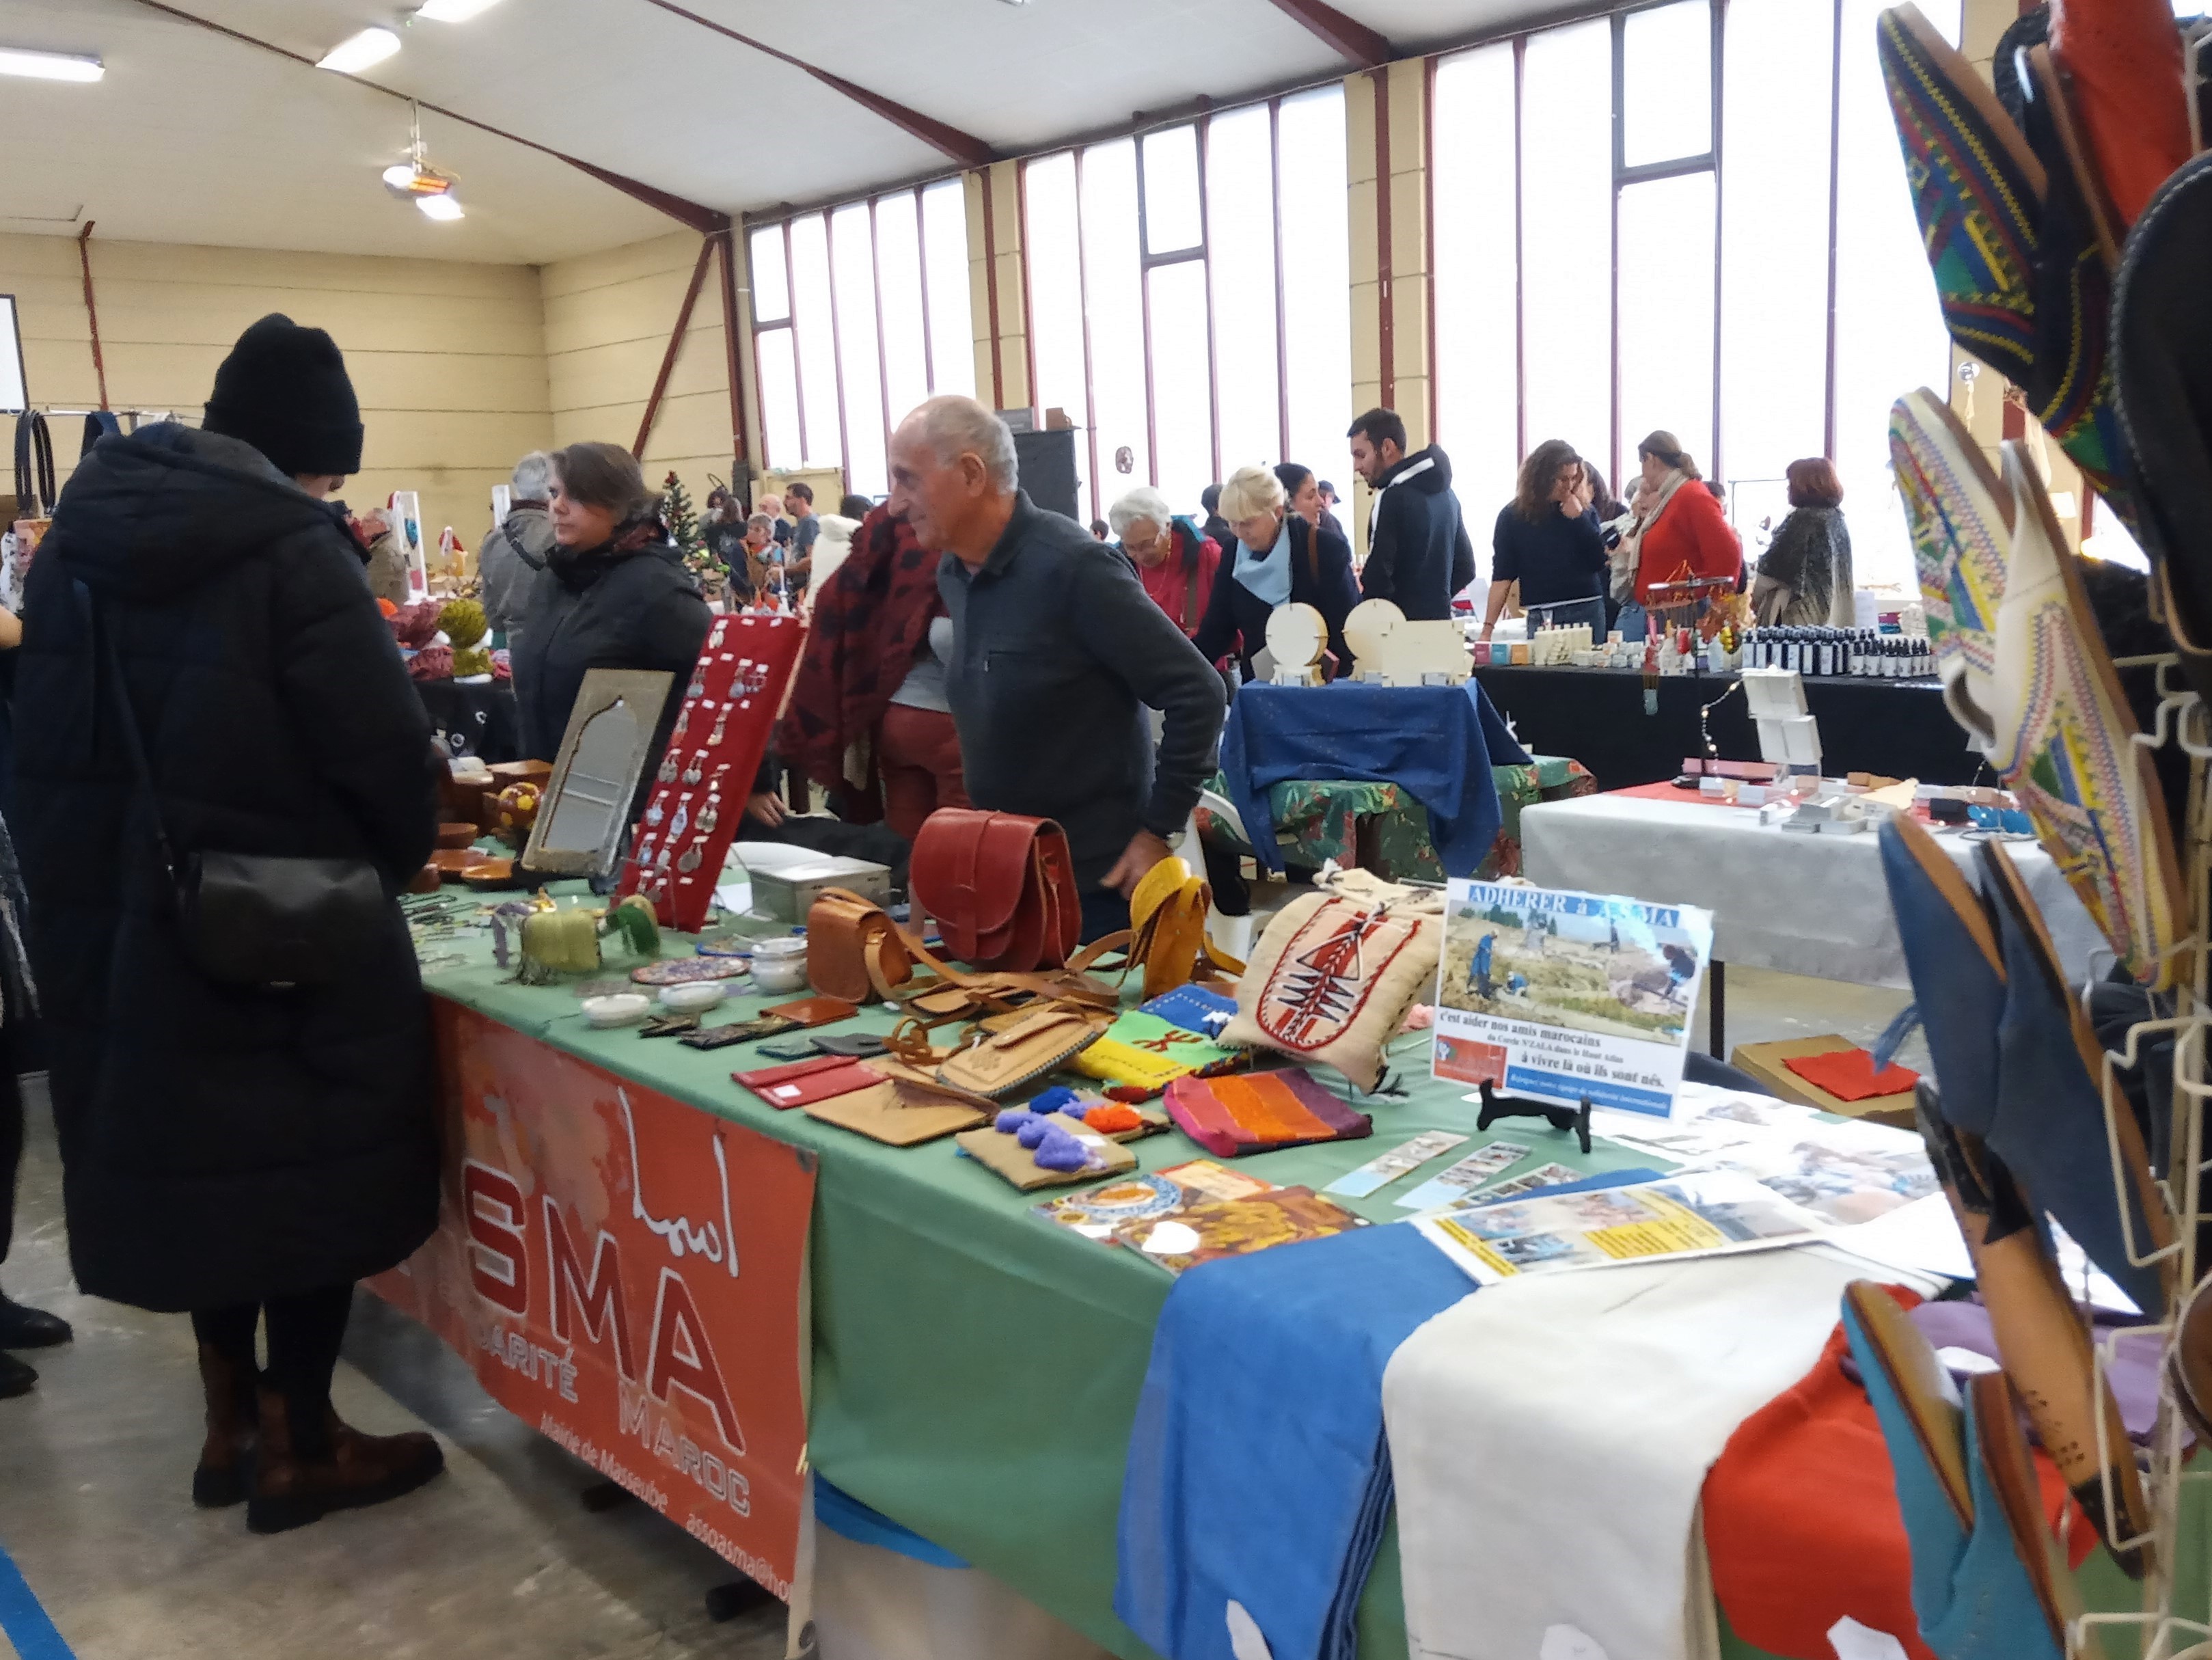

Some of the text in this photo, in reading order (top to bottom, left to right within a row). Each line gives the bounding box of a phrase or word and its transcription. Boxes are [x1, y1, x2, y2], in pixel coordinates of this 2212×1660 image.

[1470, 886, 1566, 913] ADHERER
[1440, 1011, 1601, 1047] c'est aider nos amis marocains
[1521, 1050, 1528, 1063] à
[1531, 1054, 1559, 1069] vivre
[1563, 1059, 1574, 1071] là
[1576, 1063, 1592, 1074] où
[1594, 1064, 1609, 1078] ils
[1611, 1069, 1639, 1083] sont
[481, 1324, 579, 1404] ARITÉ
[582, 1439, 599, 1468] de
[618, 1378, 751, 1518] MAROC
